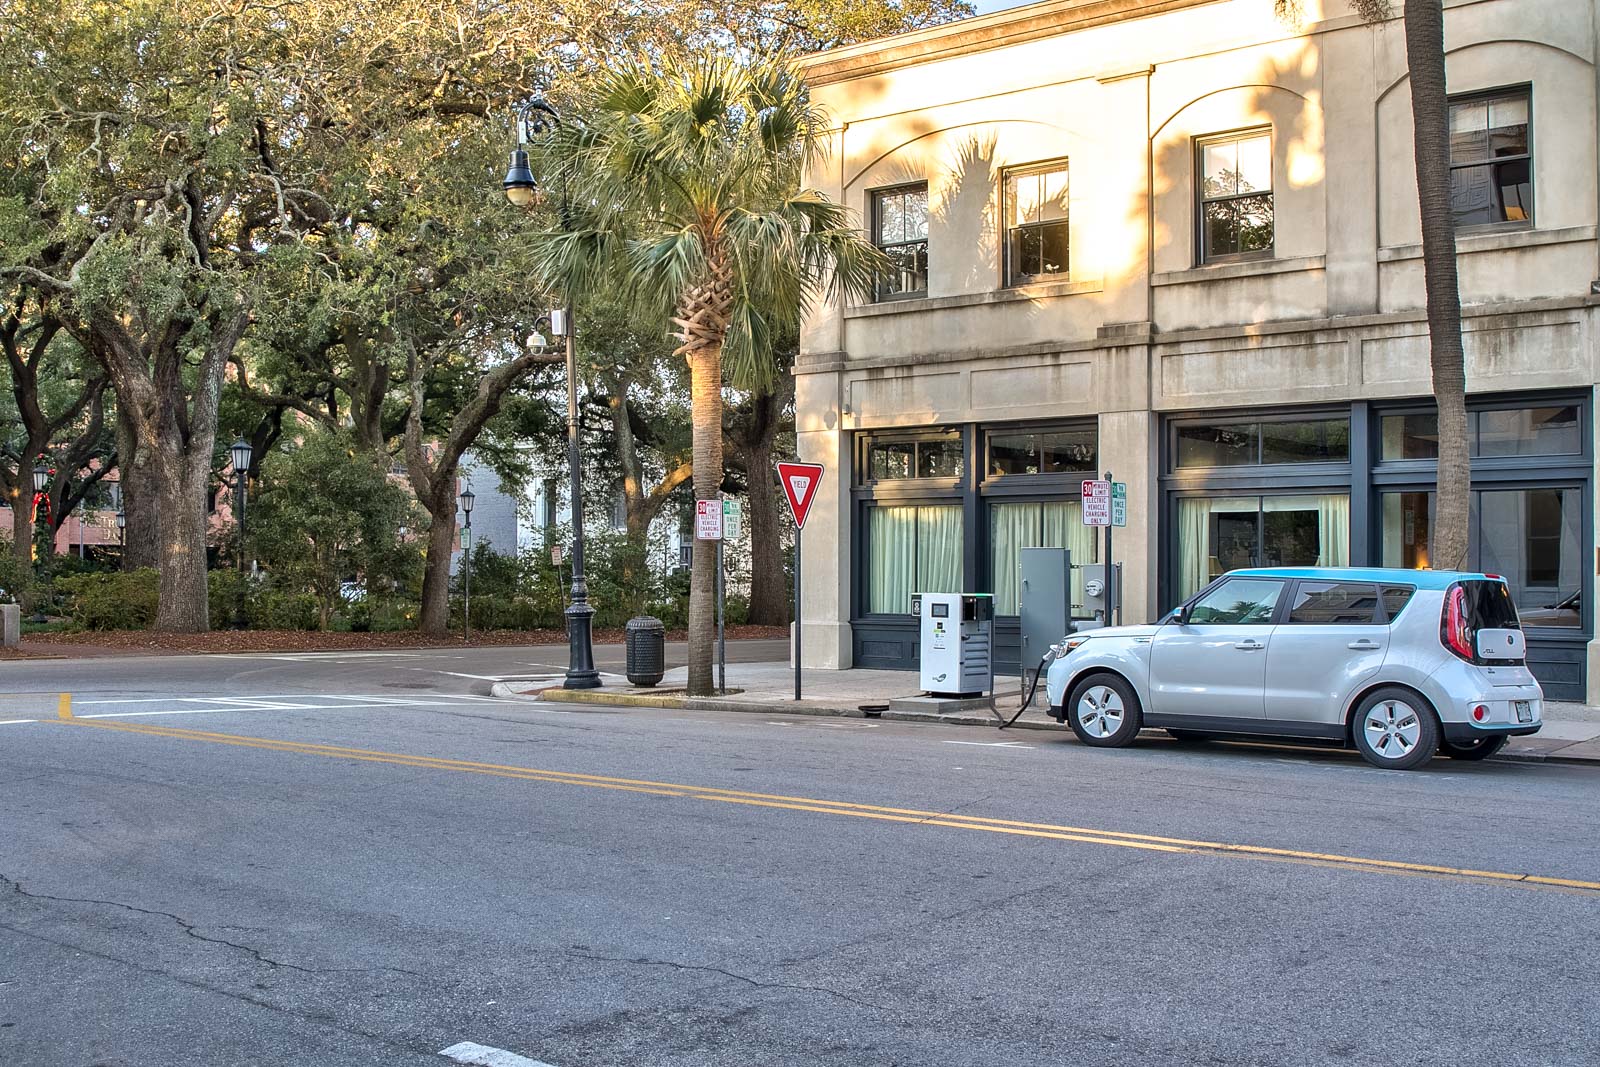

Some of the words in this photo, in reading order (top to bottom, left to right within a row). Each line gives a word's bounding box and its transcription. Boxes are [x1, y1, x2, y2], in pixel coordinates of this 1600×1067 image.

[793, 480, 807, 488] YIELD
[1083, 483, 1093, 496] 30
[698, 503, 706, 512] 30
